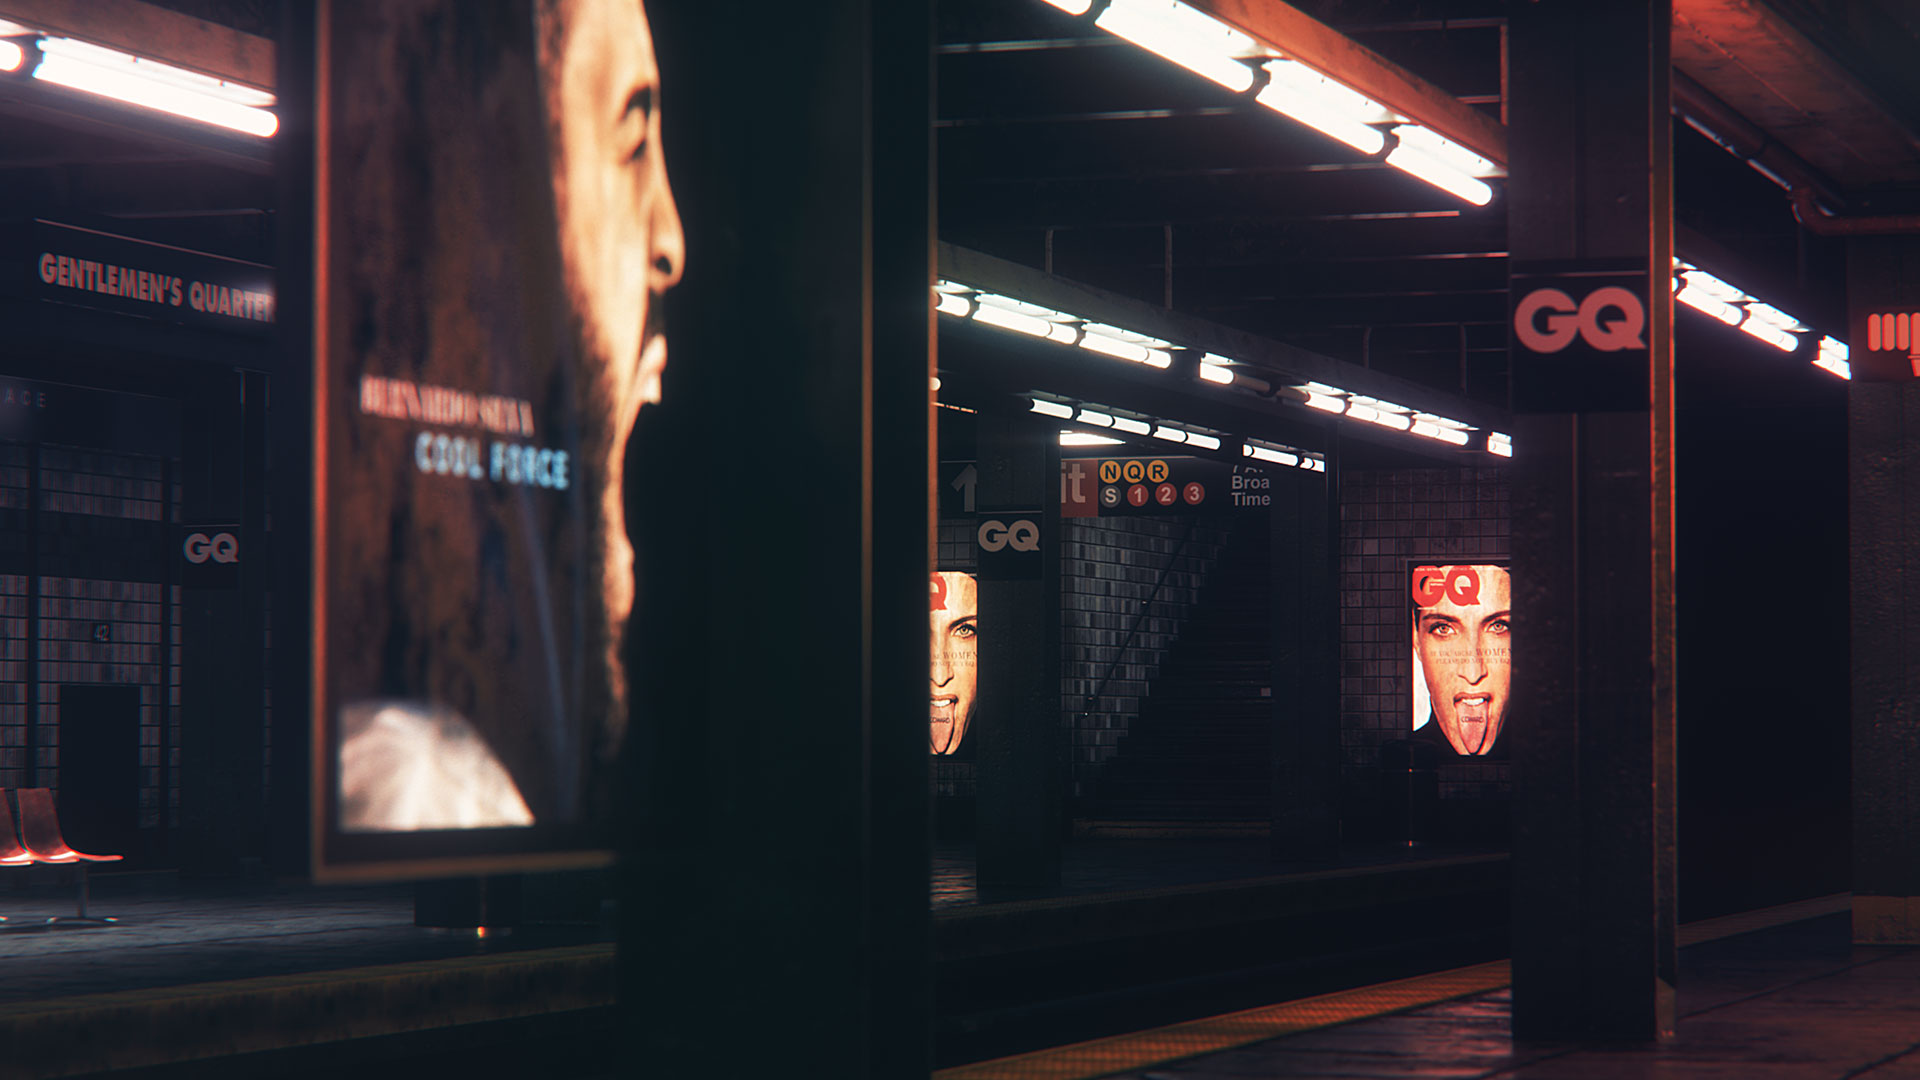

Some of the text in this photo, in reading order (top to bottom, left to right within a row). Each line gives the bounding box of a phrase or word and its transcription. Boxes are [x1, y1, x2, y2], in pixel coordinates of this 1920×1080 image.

[39, 252, 183, 307] GENTLEMEN'S
[1513, 286, 1646, 354] GQ
[1105, 464, 1164, 480] N Q R
[1231, 475, 1270, 490] Broa
[1104, 486, 1200, 503] S 1 2 3
[1231, 491, 1271, 506] Time
[184, 532, 240, 564] GQ
[977, 519, 1040, 553] GQ
[1411, 565, 1481, 607] GQ
[94, 624, 110, 641] 42
